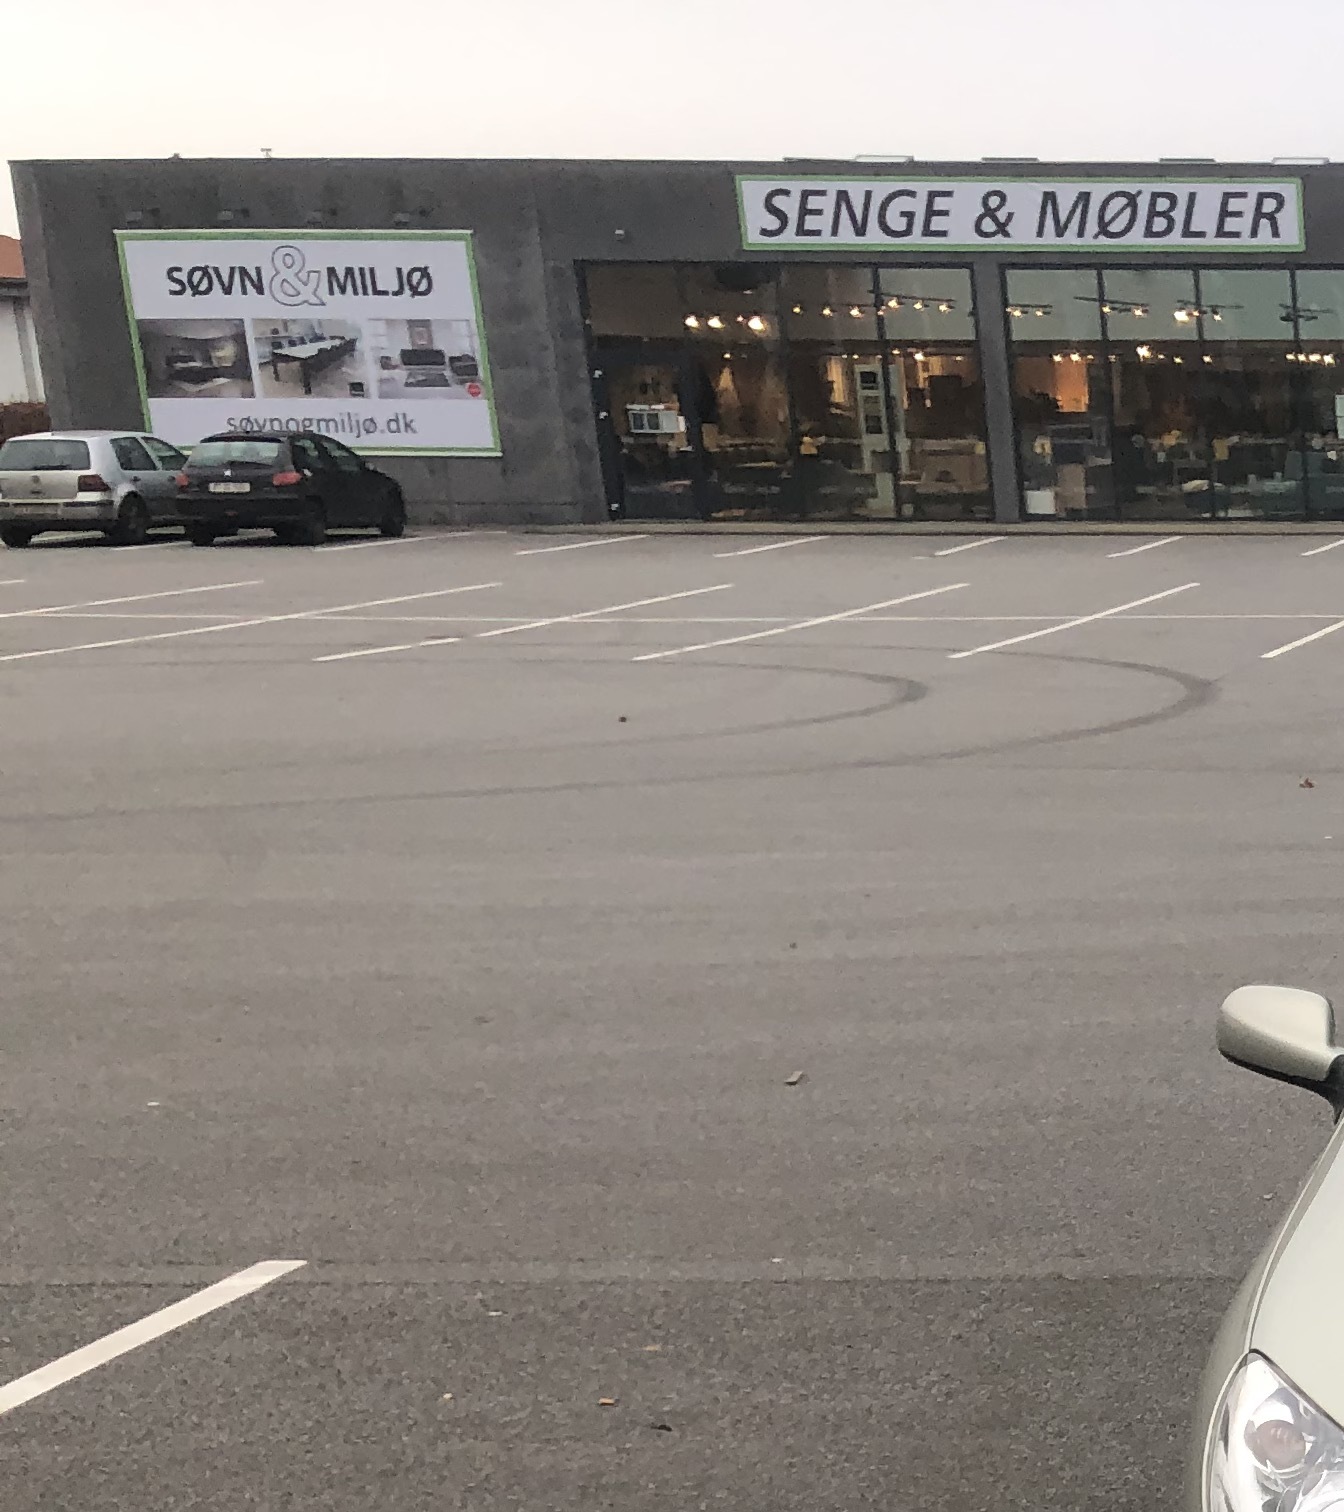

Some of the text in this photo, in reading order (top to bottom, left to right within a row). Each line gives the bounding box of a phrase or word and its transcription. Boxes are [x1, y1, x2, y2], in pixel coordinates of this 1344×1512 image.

[758, 187, 1286, 240] SENGE & MØBLER
[166, 264, 265, 297] SØVN
[327, 265, 433, 298] MILJØ
[225, 412, 418, 439] søvnogmiljø.dk
